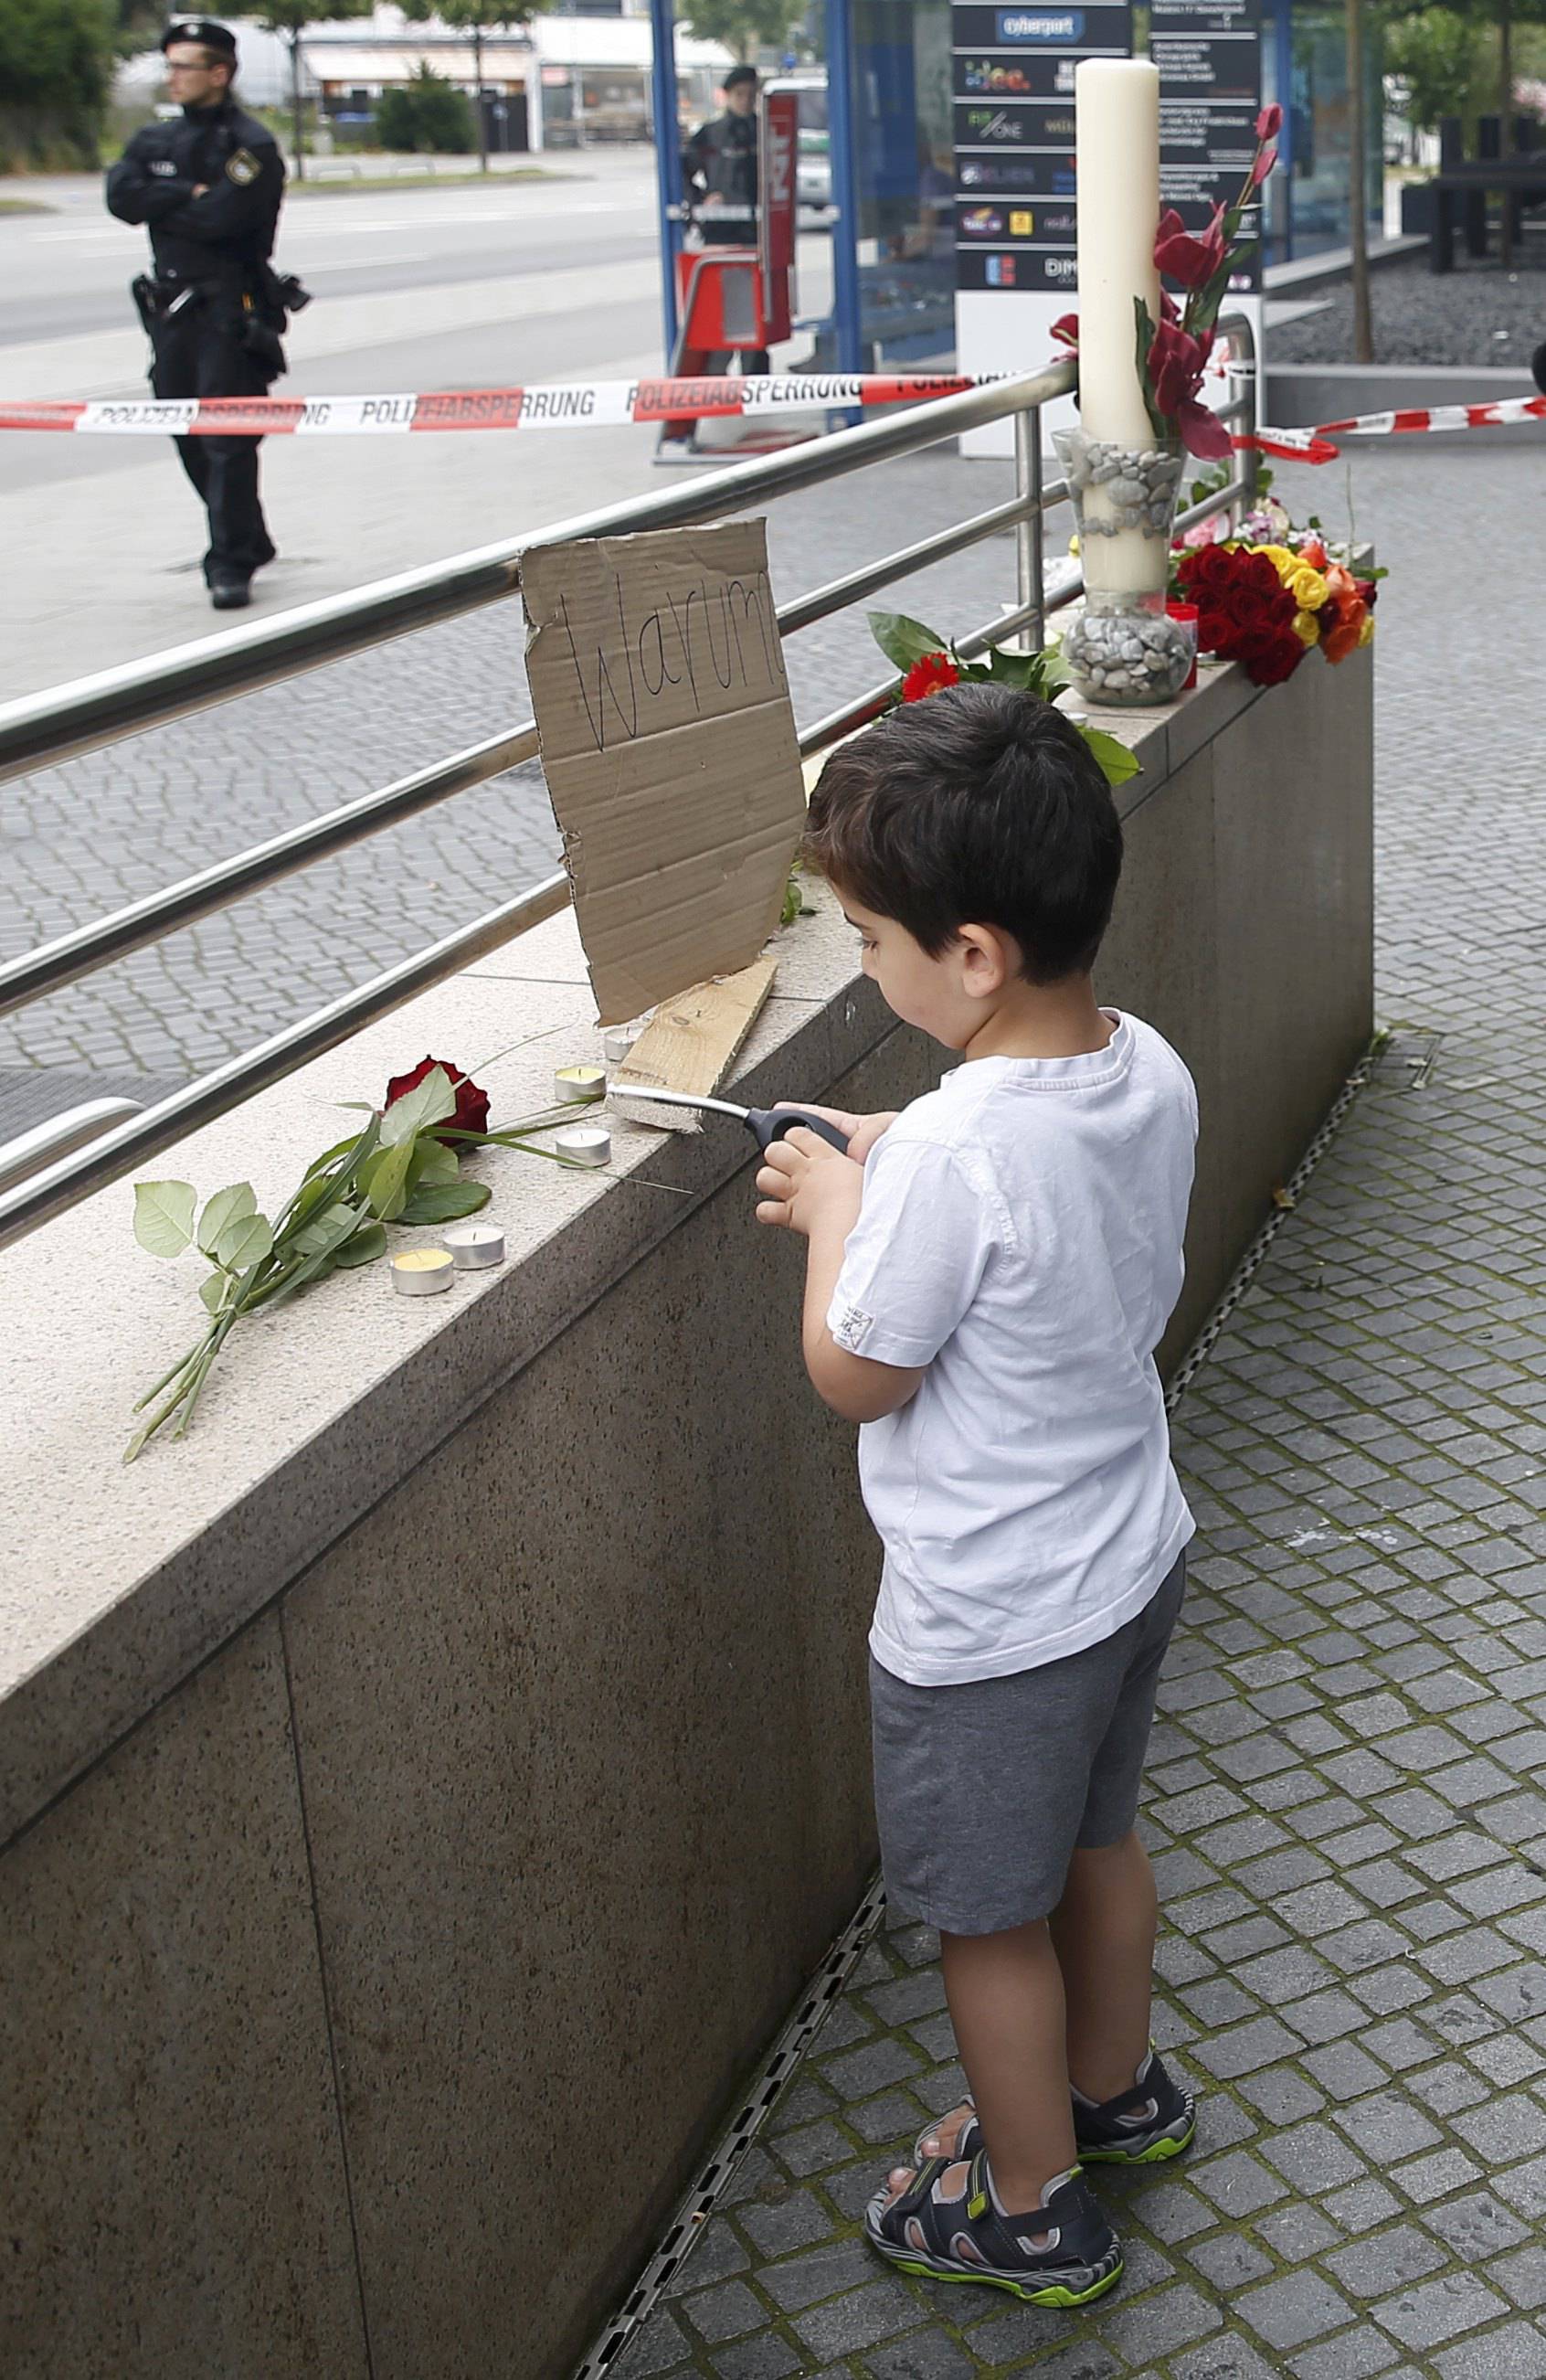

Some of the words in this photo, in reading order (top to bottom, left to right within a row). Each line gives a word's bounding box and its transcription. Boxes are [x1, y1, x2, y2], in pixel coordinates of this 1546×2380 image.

[1003, 16, 1075, 37] cyberport
[359, 390, 596, 426] POLIZEIABSPERRUNG
[625, 377, 863, 413] POLIZEIABSPERRUNG
[559, 570, 787, 753] Warum
